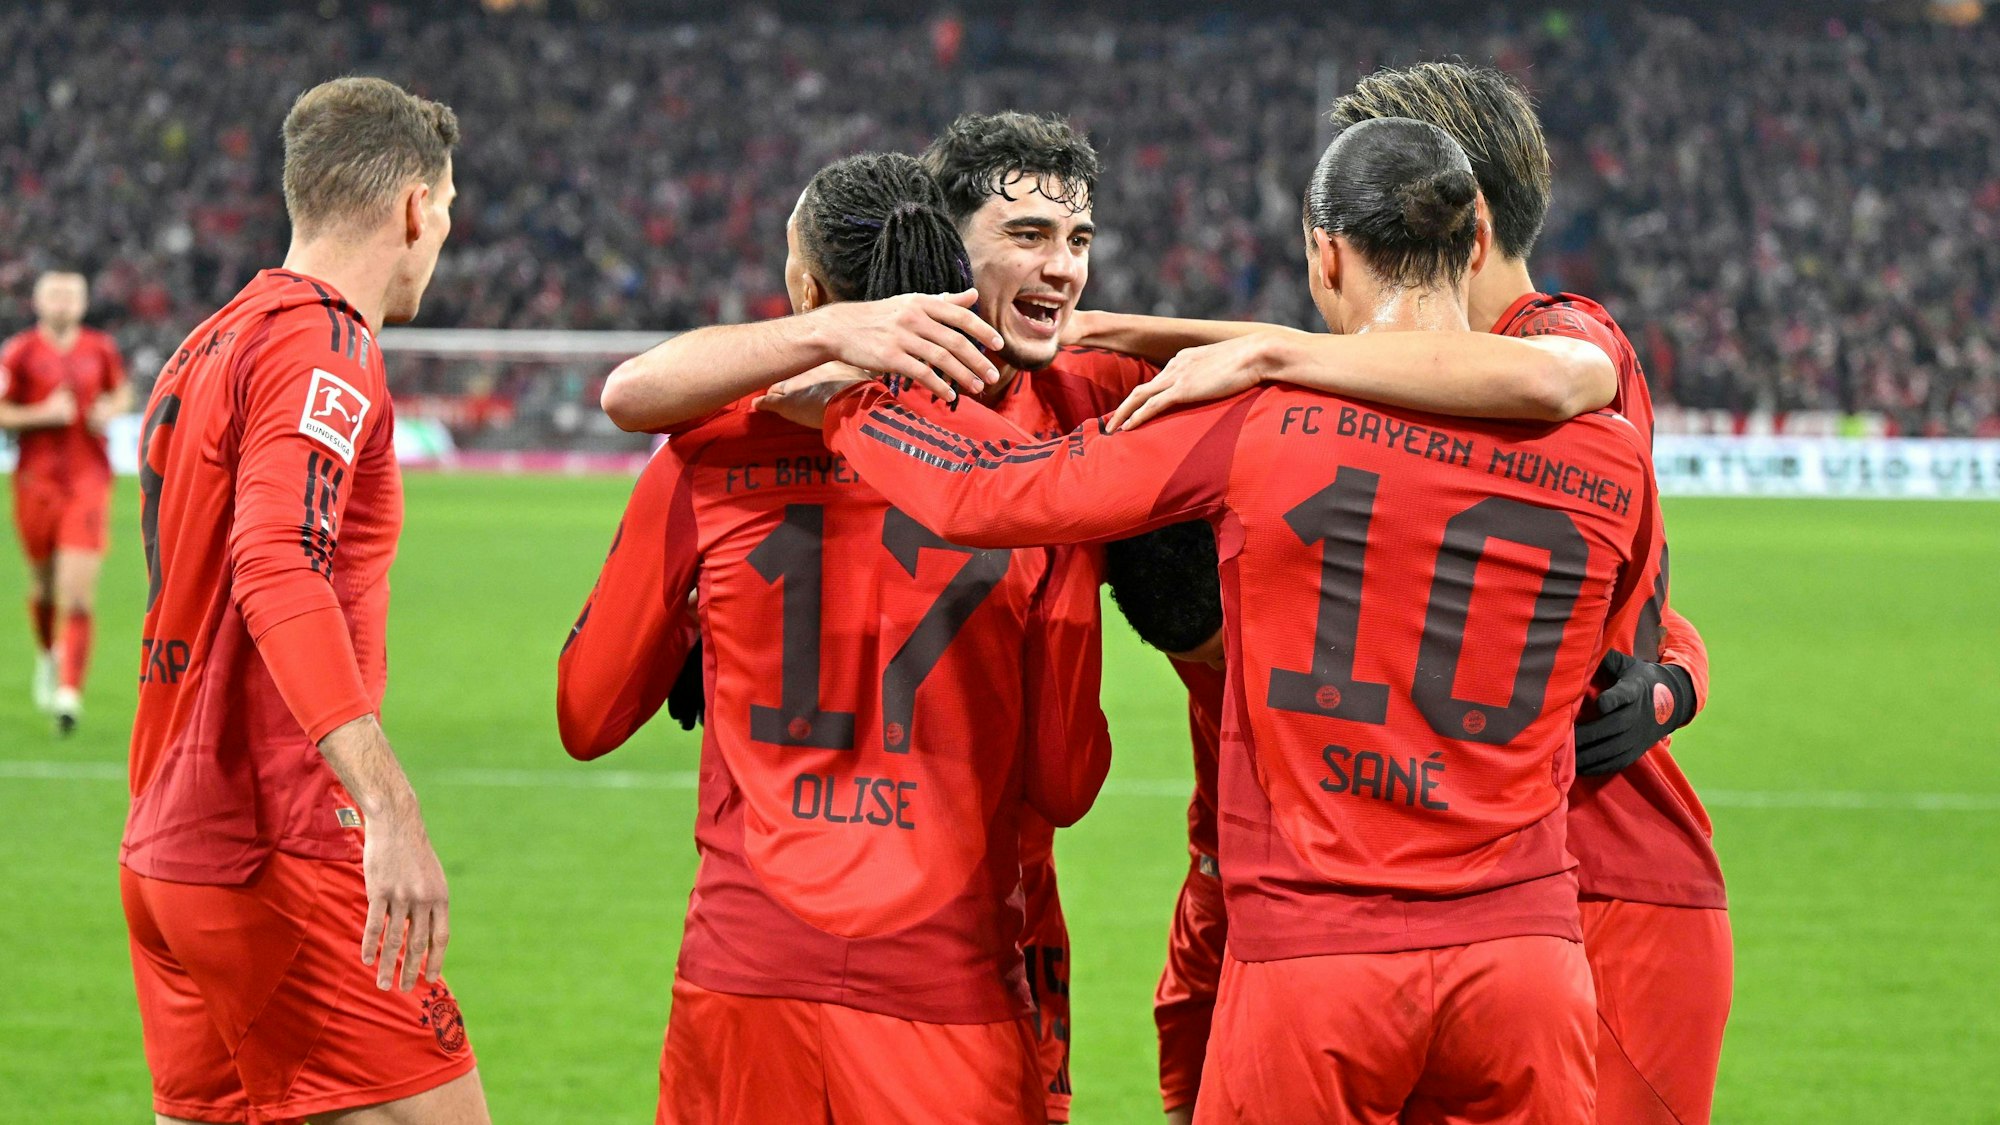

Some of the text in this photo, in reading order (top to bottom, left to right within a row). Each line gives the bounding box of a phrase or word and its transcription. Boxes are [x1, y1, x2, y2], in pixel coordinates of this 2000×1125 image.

[305, 422, 350, 455] BUNDESLIGA
[1280, 406, 1322, 436] FC
[1336, 407, 1474, 467] BAYERN
[1488, 449, 1633, 516] MÜNCHEN
[726, 456, 859, 493] FC BAYE
[746, 503, 1012, 755] 17
[1266, 465, 1590, 745] 10
[791, 772, 918, 831] OLISE
[1319, 745, 1450, 811] SANÉ
